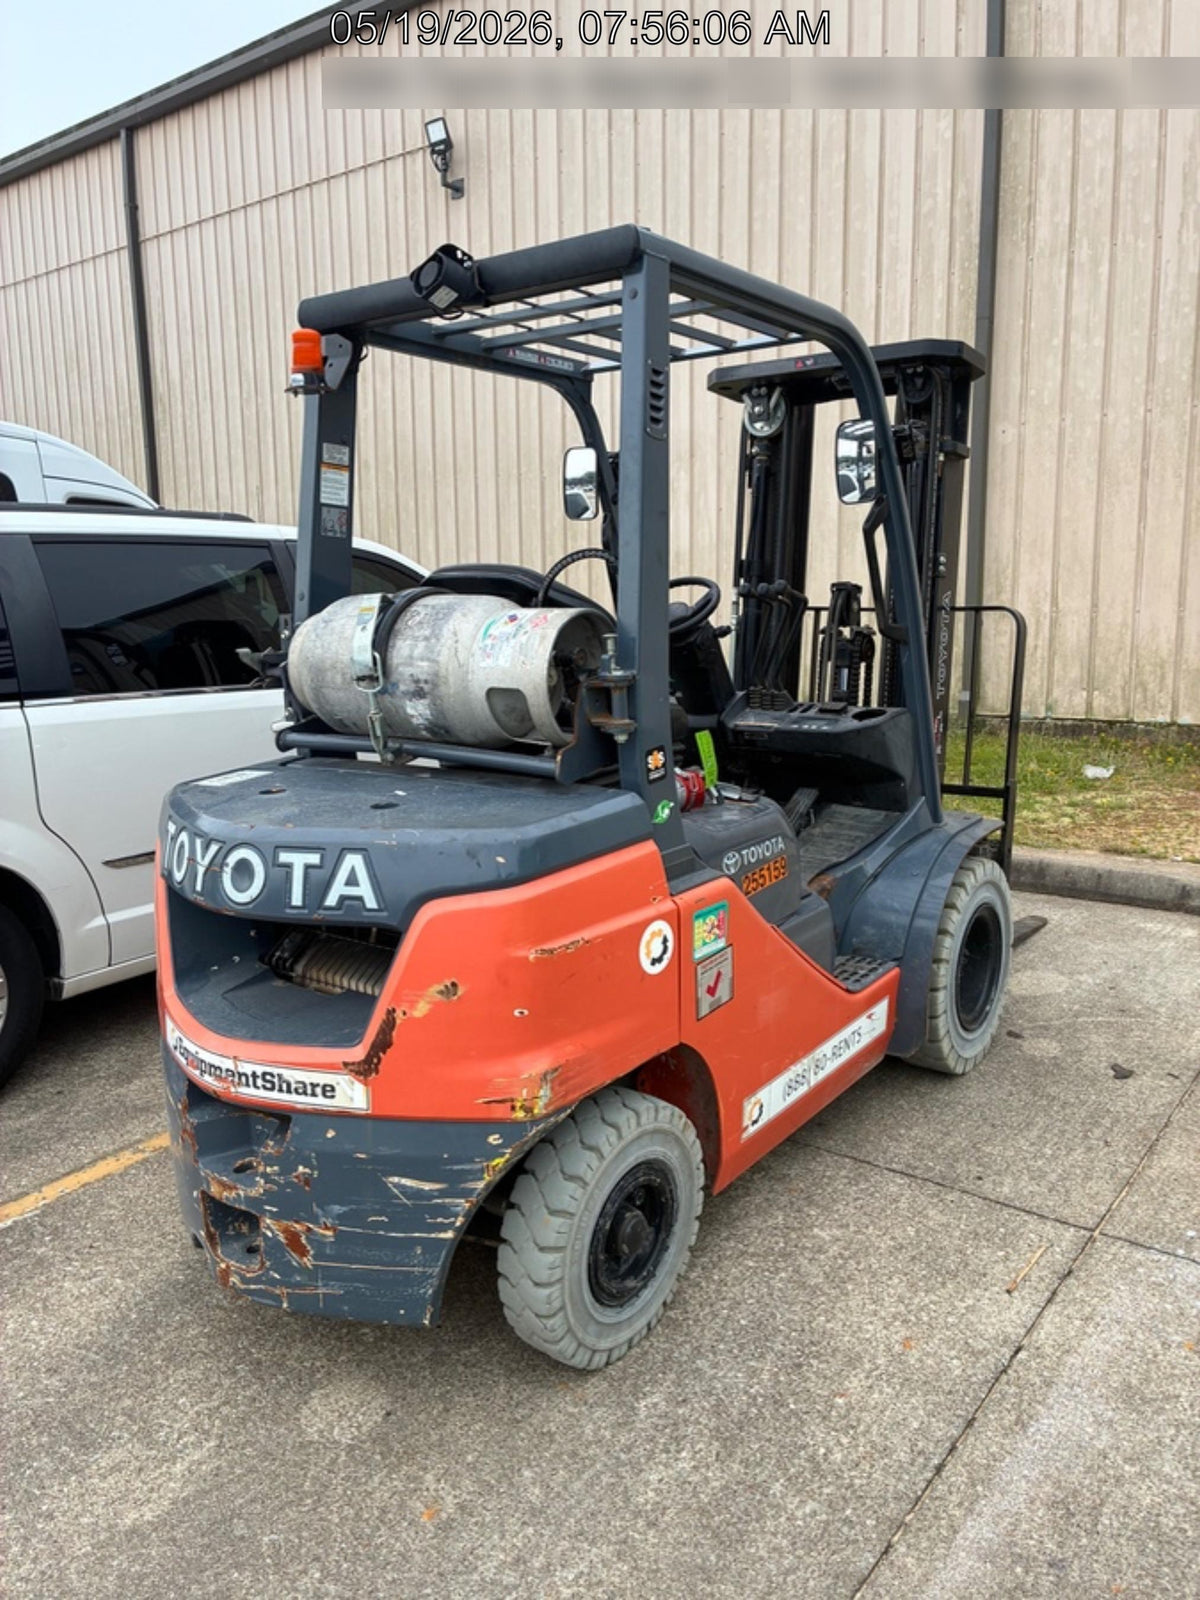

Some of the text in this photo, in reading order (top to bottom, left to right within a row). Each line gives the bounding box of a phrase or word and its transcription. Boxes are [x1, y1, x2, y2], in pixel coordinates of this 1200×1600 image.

[936, 590, 952, 700] TOYOTA
[164, 819, 381, 910] TOYOTA
[741, 836, 785, 865] TOYOTA
[742, 855, 787, 896] 255159
